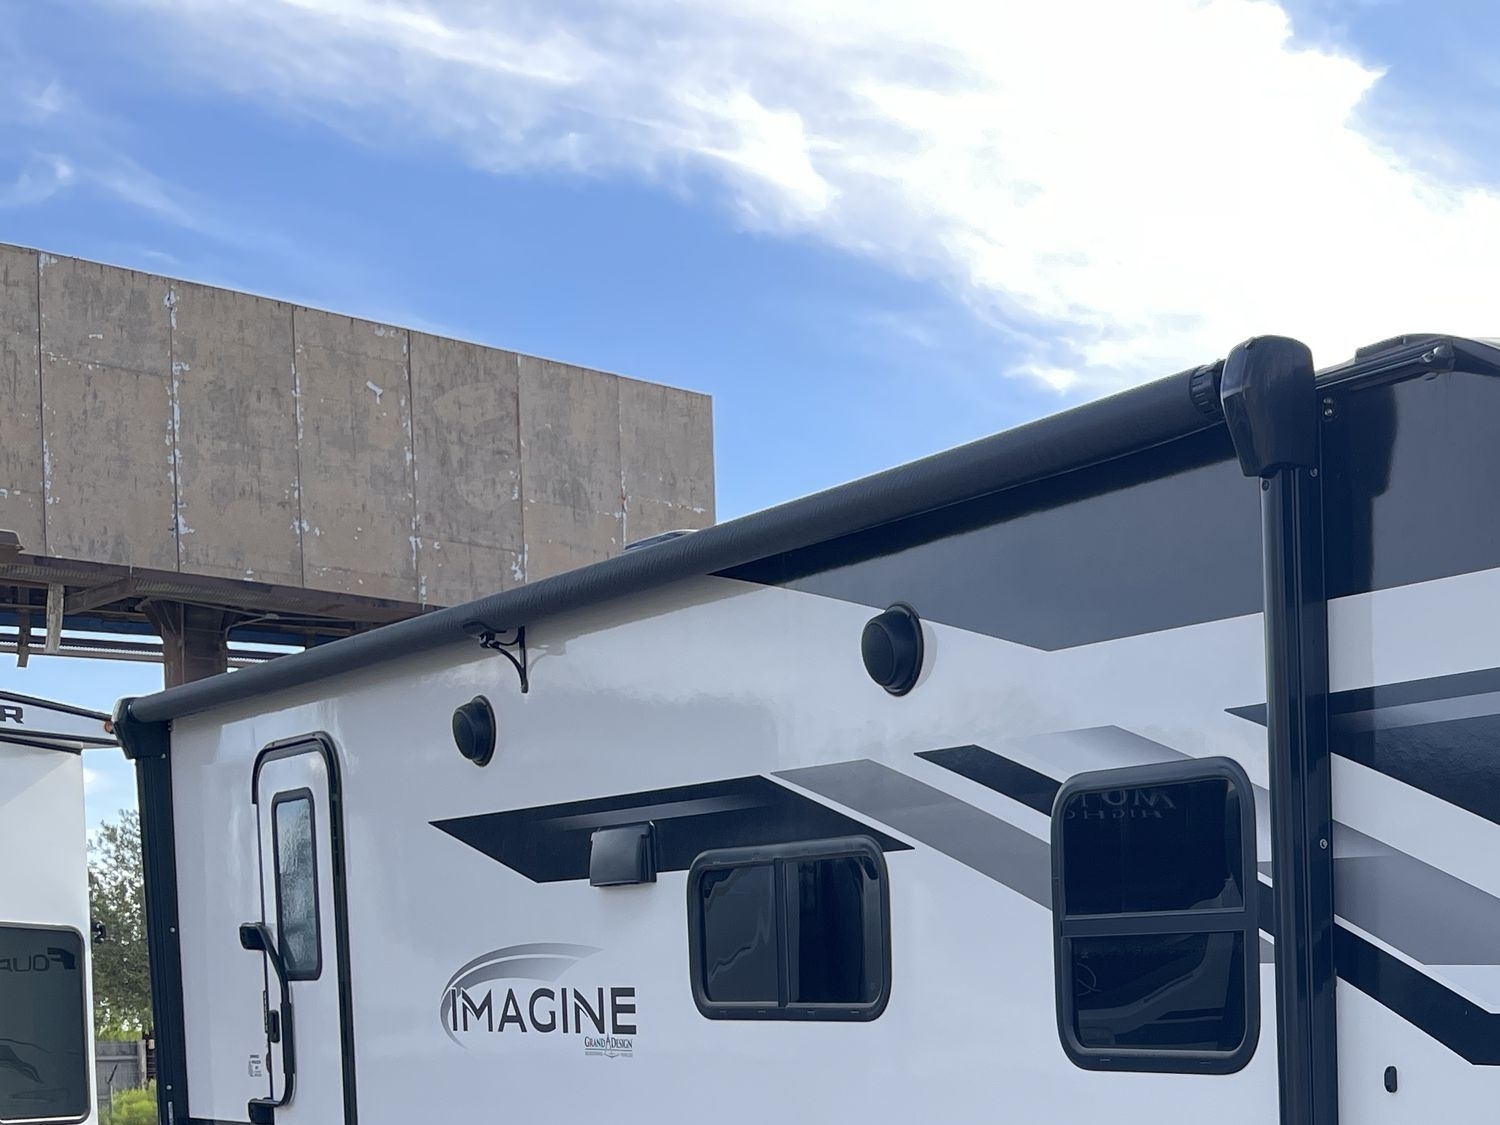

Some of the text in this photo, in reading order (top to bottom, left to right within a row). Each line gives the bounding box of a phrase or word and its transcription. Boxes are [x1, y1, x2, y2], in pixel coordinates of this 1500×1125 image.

[451, 987, 637, 1035] IMAGINE
[584, 1035, 633, 1049] GRAND DESIGN
